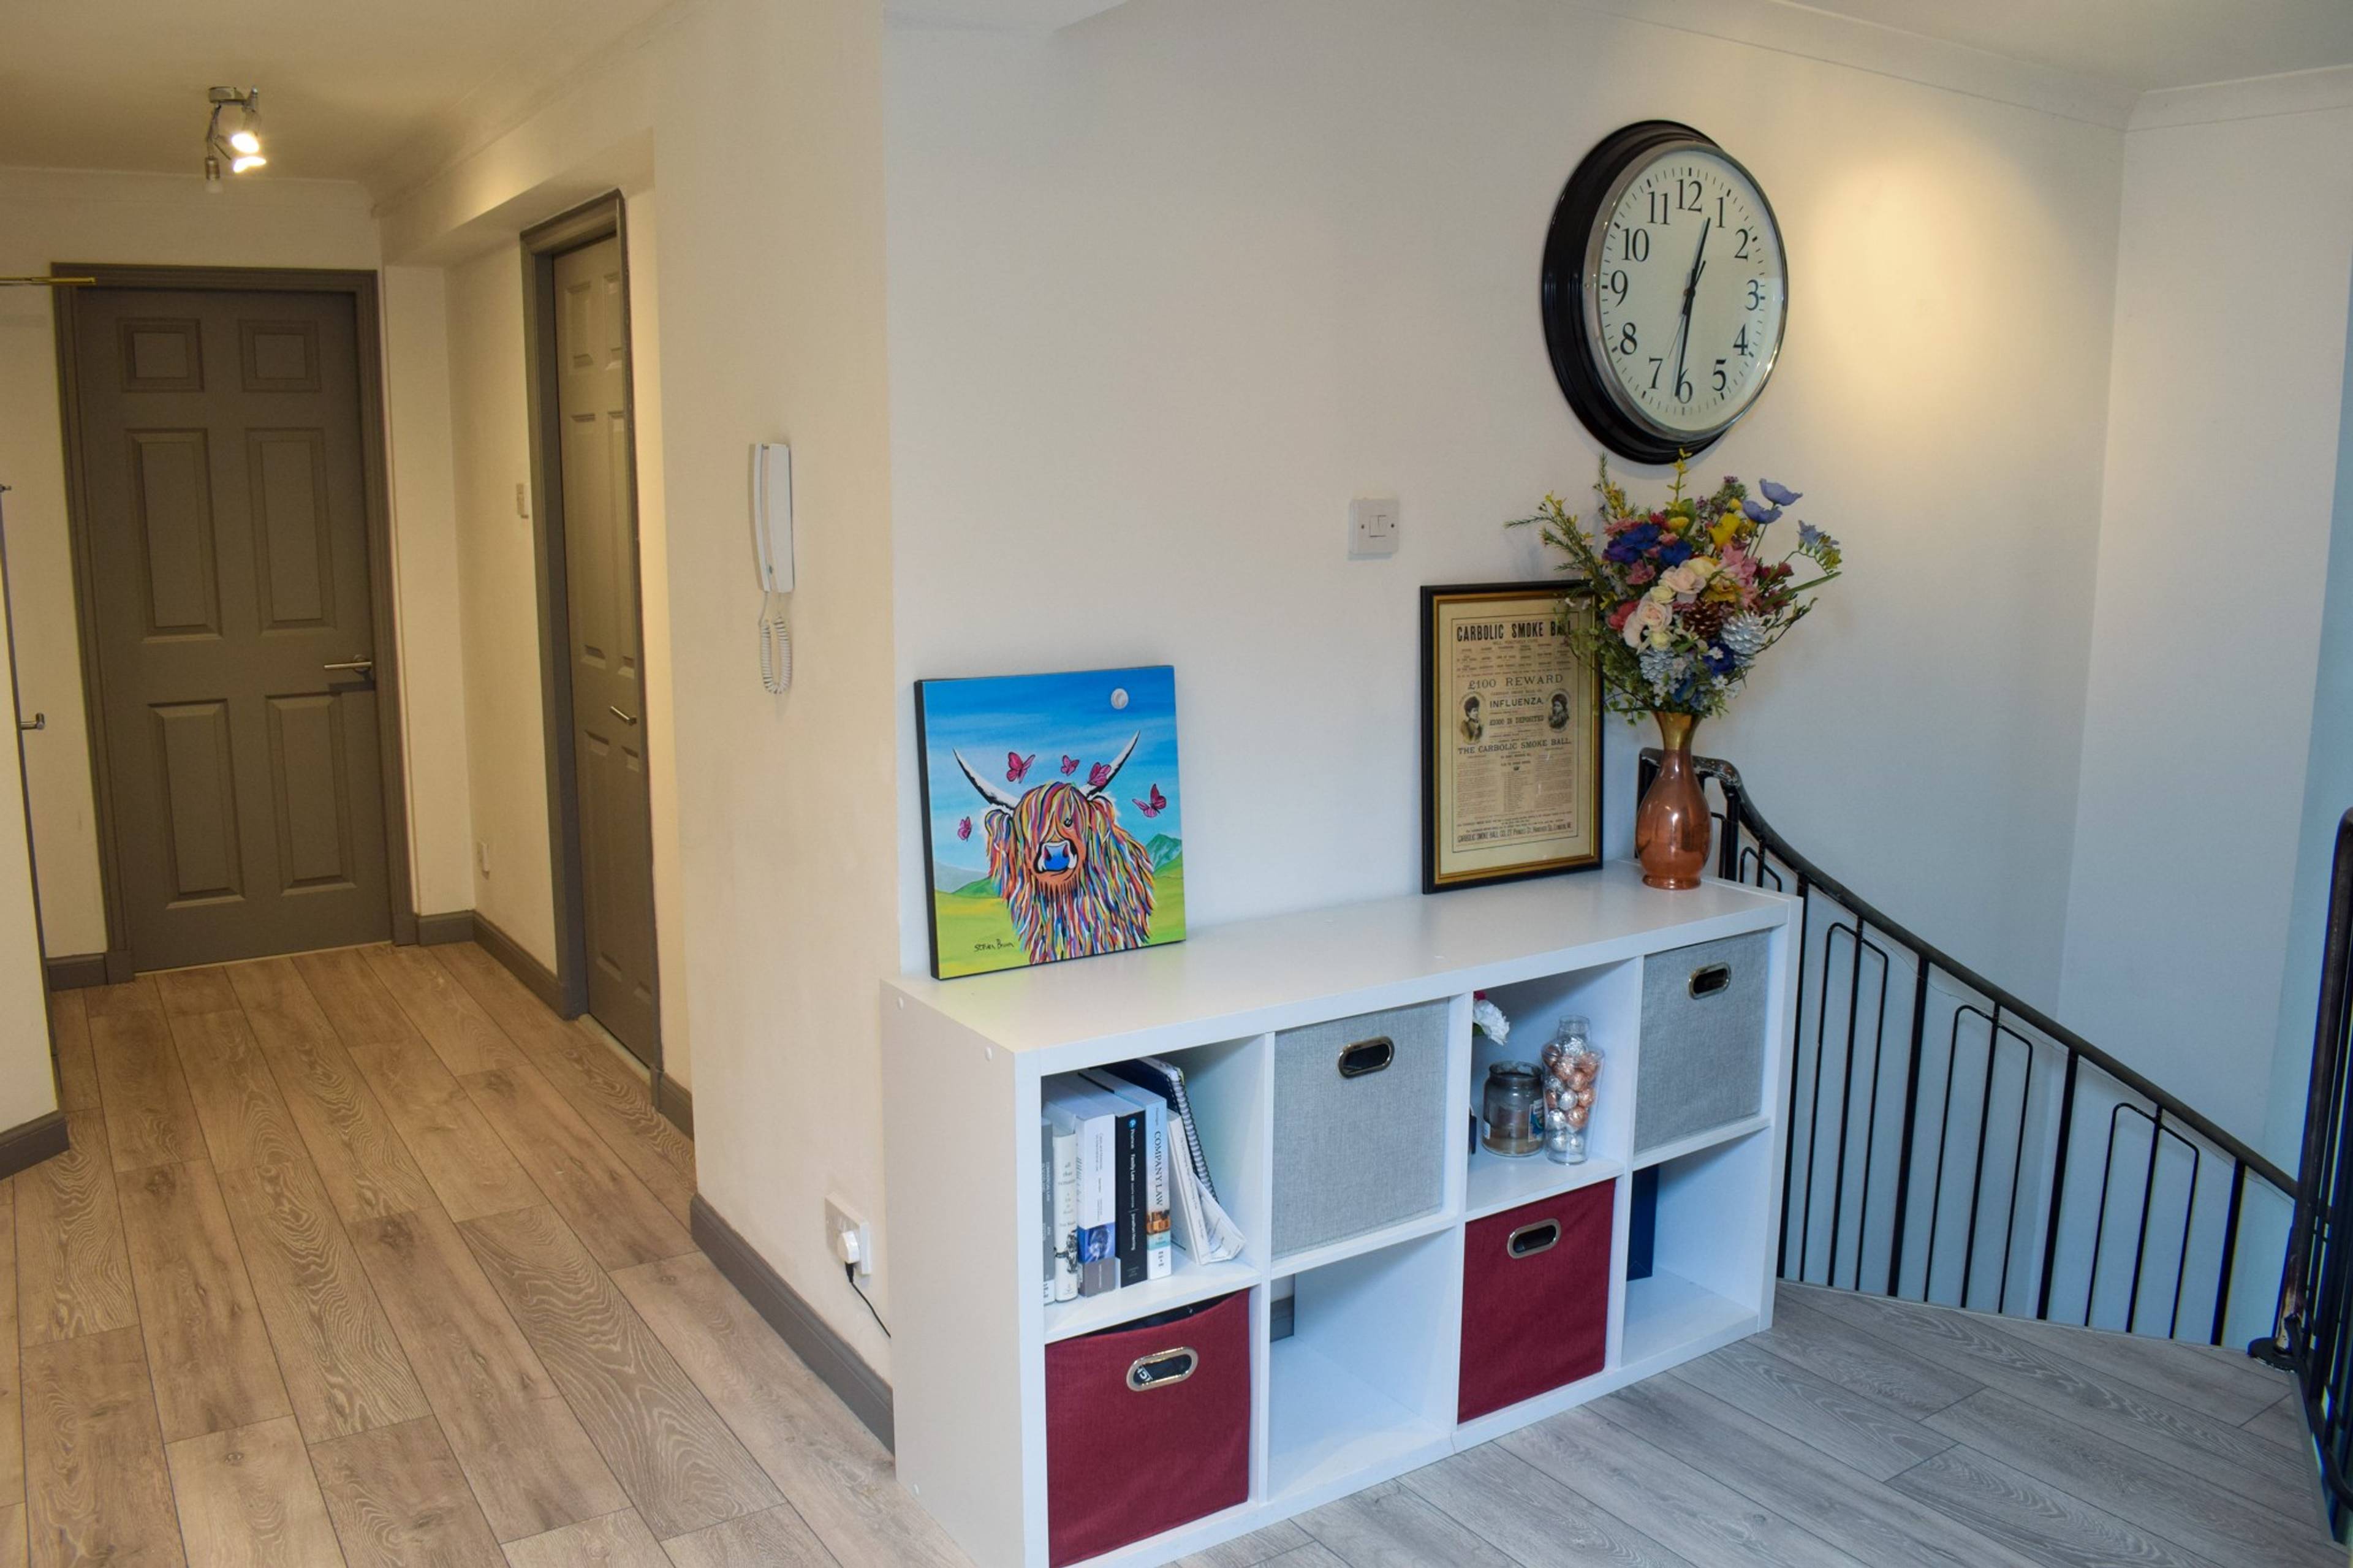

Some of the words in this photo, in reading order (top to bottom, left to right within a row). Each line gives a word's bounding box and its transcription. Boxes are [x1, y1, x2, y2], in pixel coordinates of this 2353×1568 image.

[1647, 191, 1670, 225] 11
[1675, 178, 1703, 213] 12
[1716, 195, 1726, 229] 1
[1621, 227, 1650, 262] 10
[1734, 229, 1749, 260] 2
[1610, 270, 1628, 306] 9
[1745, 279, 1759, 311] 3
[1620, 322, 1637, 355] 8
[1733, 324, 1748, 355] 4
[1648, 357, 1664, 390] 7
[1678, 368, 1693, 404] 6
[1713, 358, 1727, 392] 5
[1457, 624, 1504, 642] CARBOLIC
[1512, 621, 1544, 638] SMOKE
[1468, 679, 1496, 690] £100
[1506, 674, 1563, 687] REWARD
[1458, 746, 1475, 755] THE
[1478, 743, 1517, 753] CARBOLIC
[1521, 740, 1547, 749] SMOKE
